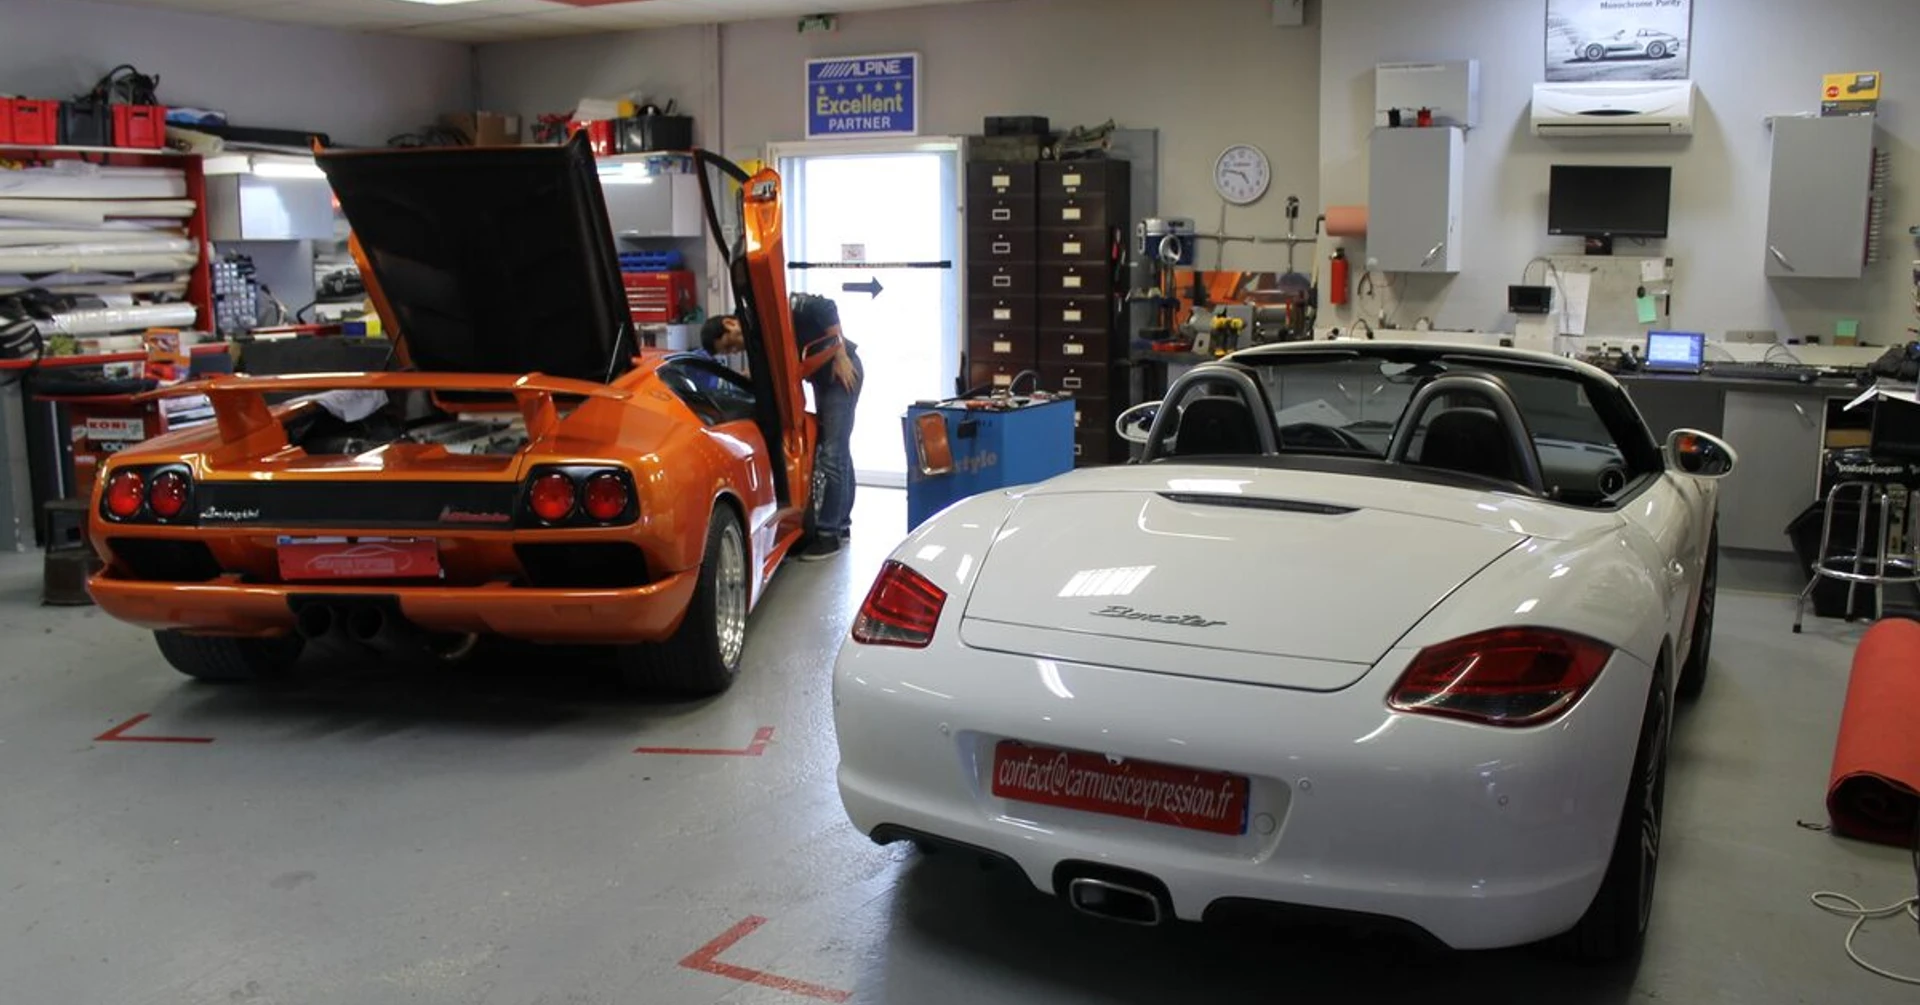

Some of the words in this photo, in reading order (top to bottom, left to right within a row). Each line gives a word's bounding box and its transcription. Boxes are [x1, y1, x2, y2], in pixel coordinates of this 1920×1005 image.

[1600, 1, 1653, 9] Monochrome
[842, 60, 901, 76] ALPINE
[816, 94, 904, 116] Excellent
[828, 116, 892, 131] PARTNER
[89, 421, 128, 429] KONI
[1089, 605, 1227, 628] Boxster
[999, 752, 1234, 820] contact@carmusicexpression.fr
